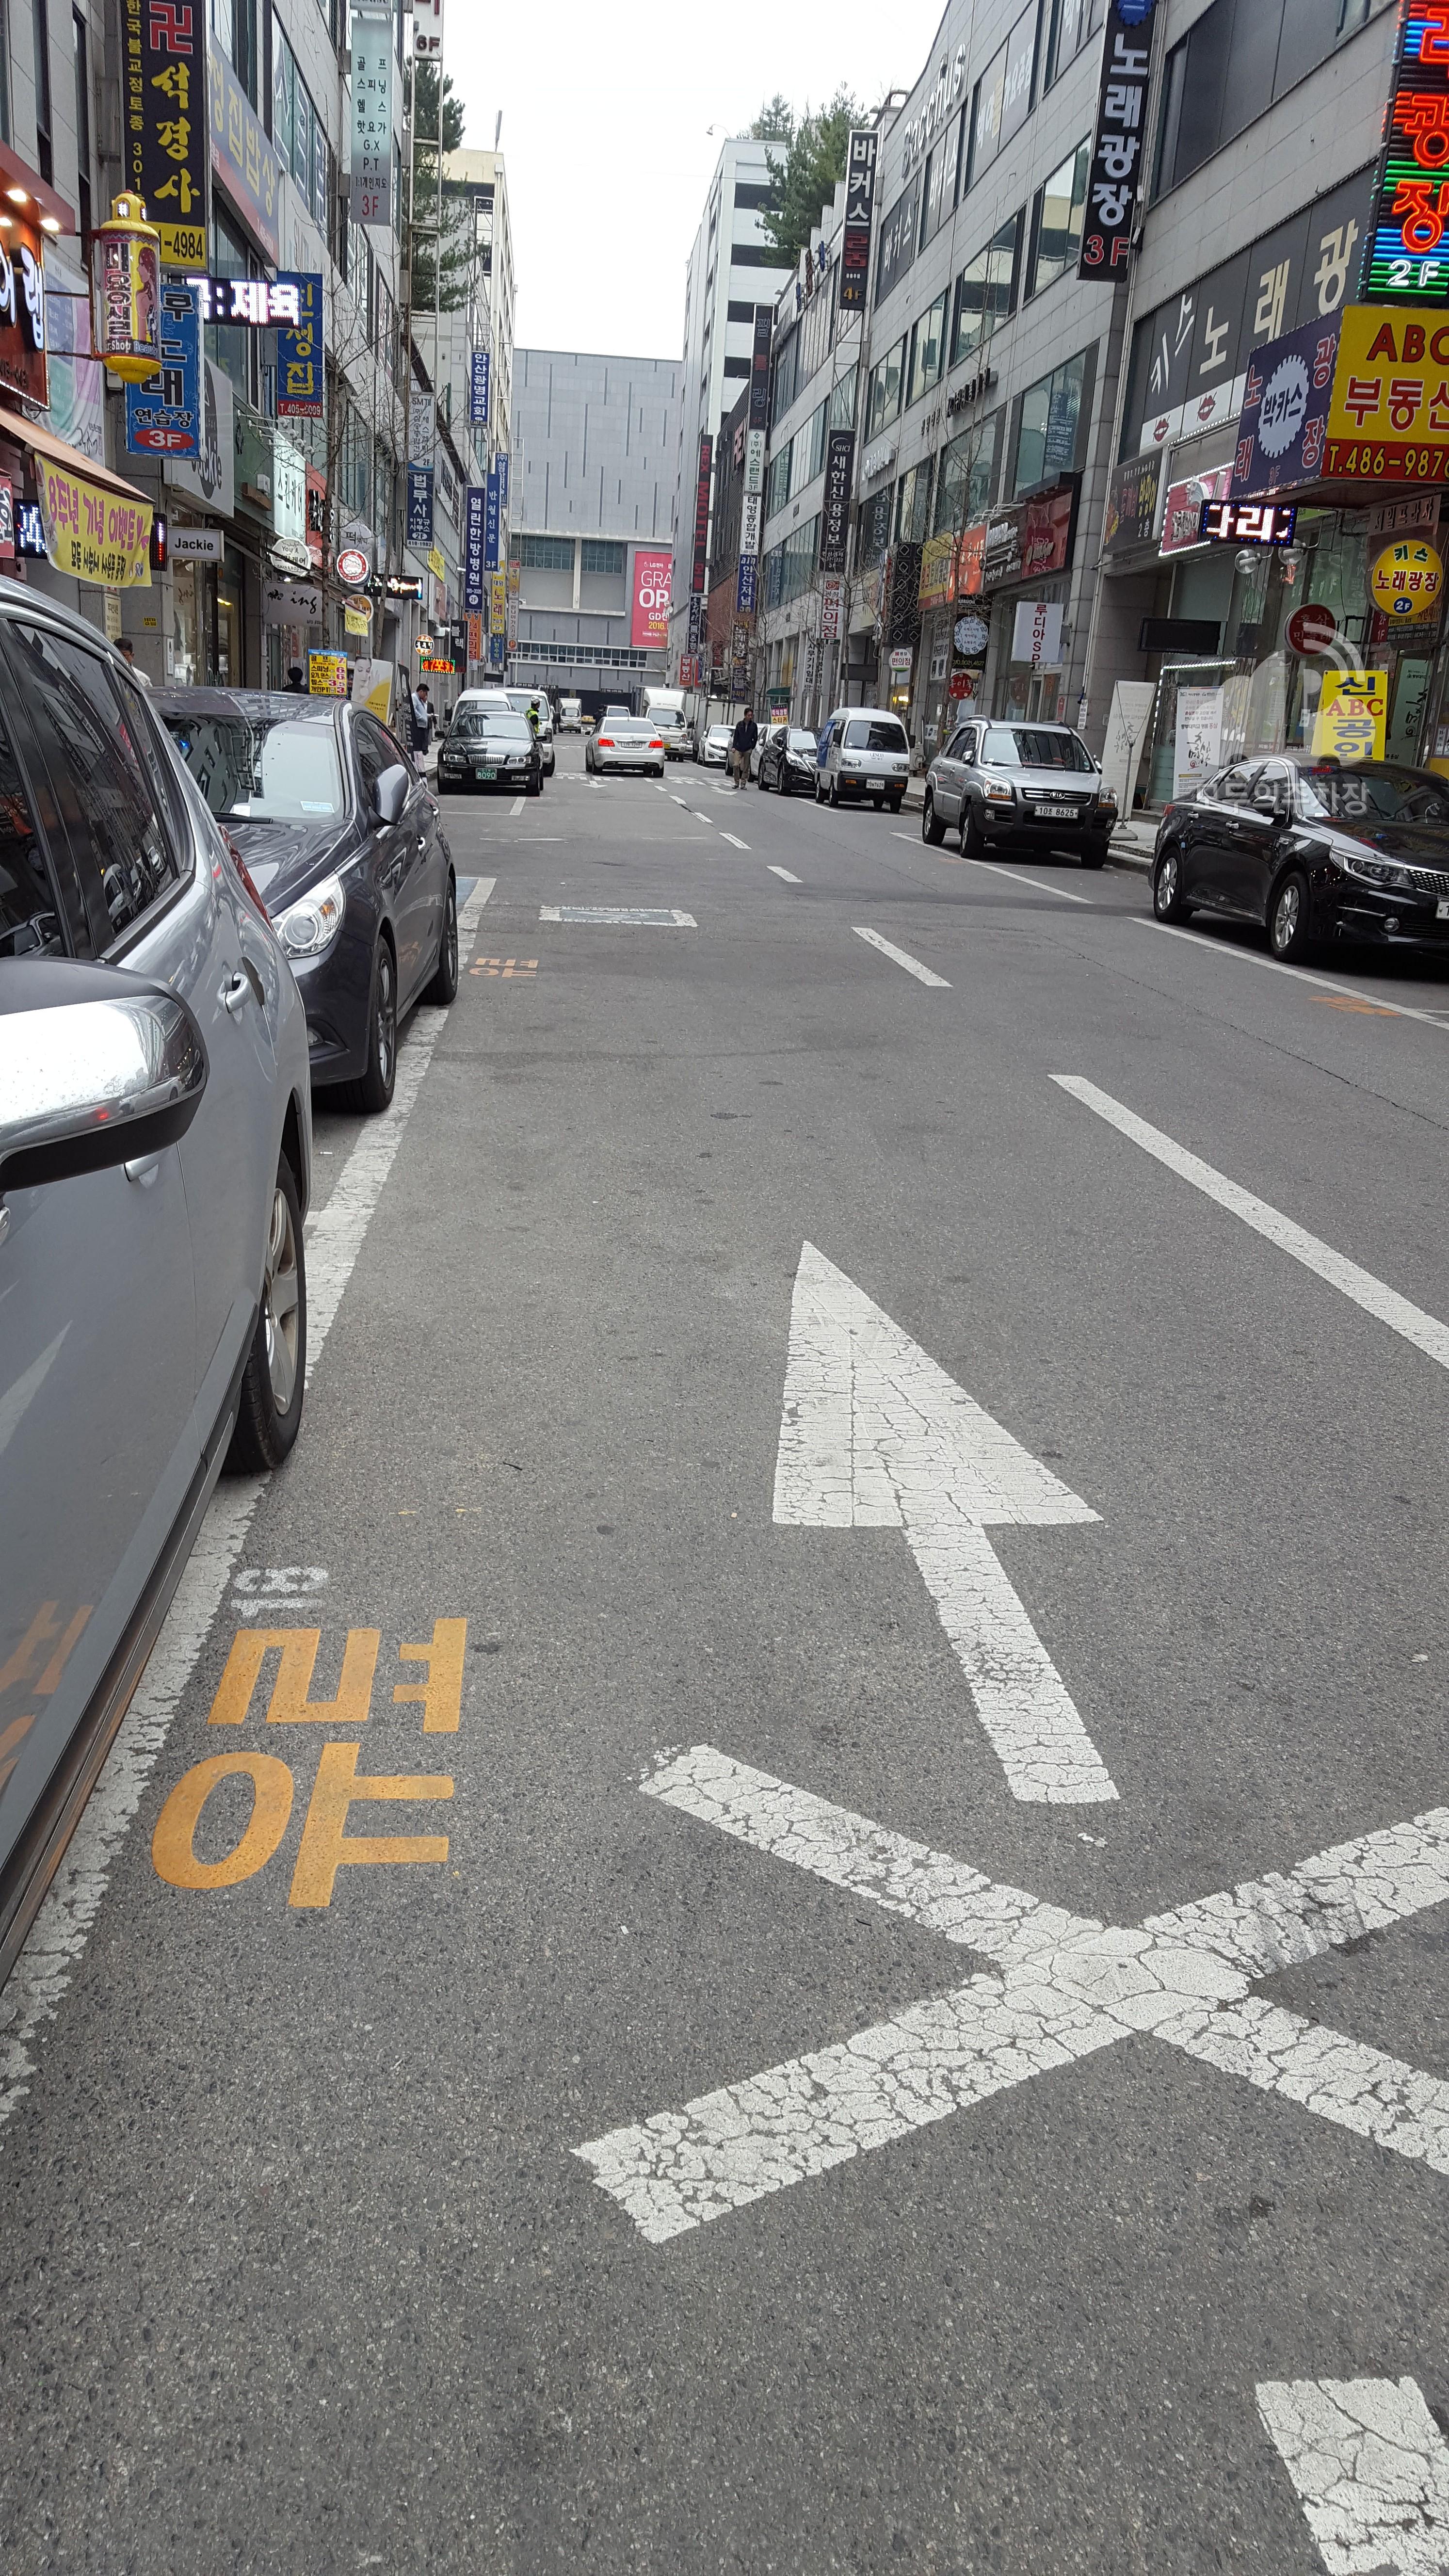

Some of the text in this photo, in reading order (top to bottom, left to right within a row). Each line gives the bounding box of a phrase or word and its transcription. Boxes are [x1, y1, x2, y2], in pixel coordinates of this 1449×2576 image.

[417, 35, 440, 51] 6F
[357, 78, 386, 94] 스피닝
[357, 99, 386, 113] 헬스
[151, 61, 201, 214] 석경사
[357, 120, 387, 135] 핫요가
[1092, 33, 1148, 226] 노래광장
[364, 140, 380, 152] G.X
[132, 142, 145, 200] 301
[364, 158, 379, 171] P.T
[355, 176, 387, 190] 1:1개인지도
[846, 140, 876, 227] 바커스
[362, 195, 379, 217] 3F
[1083, 235, 1129, 266] 3F
[1388, 260, 1440, 288] 2F
[104, 242, 132, 337] 미용실
[843, 287, 863, 301] 4F
[134, 408, 194, 429] 연습장
[149, 430, 181, 448] 3F
[413, 474, 428, 518] 법무사
[826, 456, 847, 545] 새한신용정보
[48, 473, 79, 534] 8주년
[83, 492, 104, 546] 기념
[108, 505, 135, 551] 이벤트
[487, 490, 498, 544] 반월신문
[695, 481, 709, 547] MOTEL
[744, 496, 758, 549] 태영종합개발
[175, 538, 214, 551] Jackie
[469, 497, 482, 586] 열린한방병원
[1394, 544, 1429, 563] 키스
[71, 540, 81, 570] 모든
[740, 564, 755, 607] 안산저널
[1374, 569, 1439, 593] 노래광장
[290, 590, 318, 615] ing
[493, 590, 503, 615] 노래
[1396, 601, 1410, 611] 2F
[823, 598, 839, 639] 편의점
[681, 658, 691, 681] 부동산
[805, 644, 815, 685] 사무기기임대
[891, 657, 911, 666] 편의점
[1335, 676, 1376, 696] 신
[1326, 698, 1384, 717] ABC
[1040, 807, 1075, 818] 10조 8625
